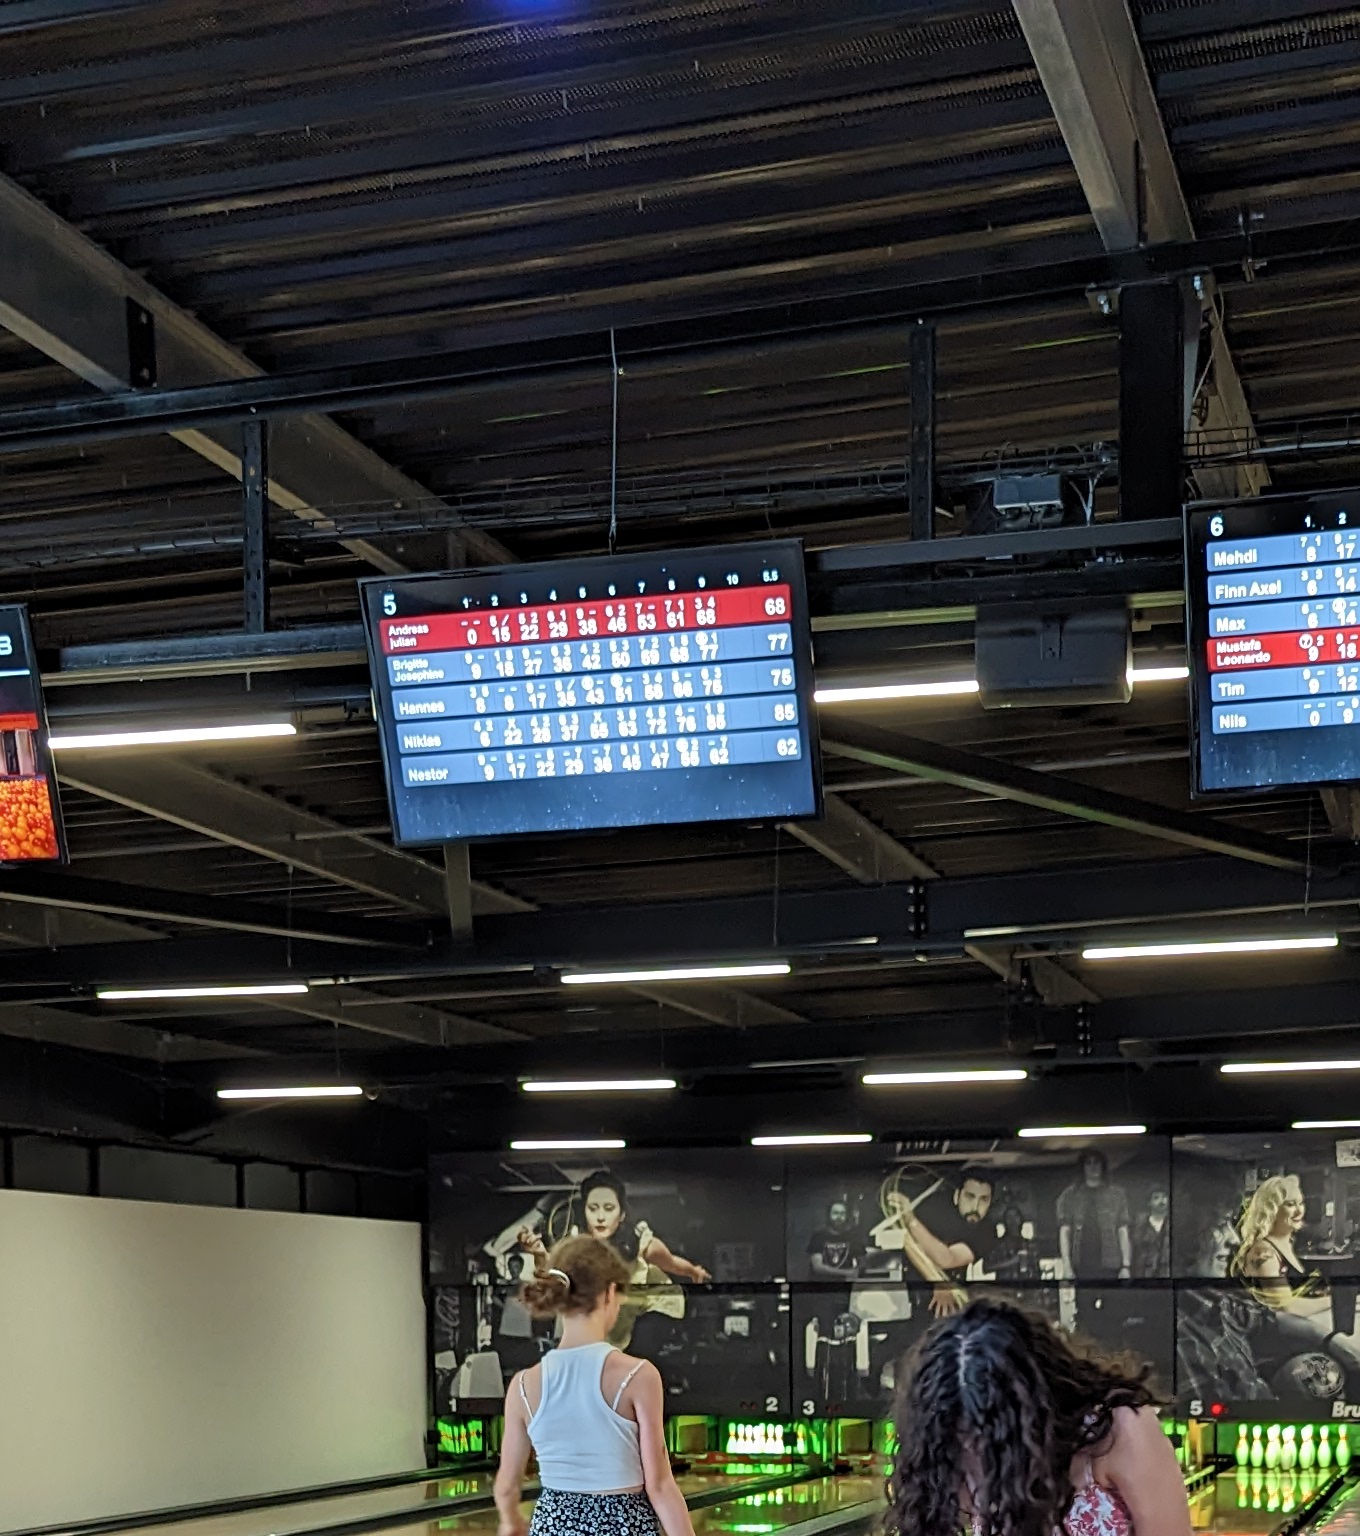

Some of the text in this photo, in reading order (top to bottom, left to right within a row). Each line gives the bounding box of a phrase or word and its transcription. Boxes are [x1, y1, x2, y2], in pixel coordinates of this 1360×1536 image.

[1210, 517, 1223, 536] 6
[1305, 515, 1311, 528] 1
[1339, 512, 1346, 524] 2
[1214, 550, 1257, 566] Mehdi
[1337, 543, 1355, 559] 17
[1216, 580, 1282, 599] Finn Axel
[1337, 577, 1356, 592] 14
[383, 593, 396, 615] 5
[491, 595, 498, 606] 2
[521, 593, 527, 604] 3
[549, 590, 557, 601] 4
[638, 582, 645, 593] 7
[727, 574, 739, 585] 10
[520, 624, 539, 640] 22
[765, 598, 786, 615] 68
[1217, 617, 1245, 632] Max
[388, 624, 429, 636] Andreas
[700, 645, 718, 659] 77
[768, 634, 788, 650] 77
[1217, 640, 1261, 653] Mustafa
[1217, 652, 1271, 666] Leonardo
[771, 668, 792, 686] 75
[1339, 676, 1357, 691] 12
[1218, 682, 1245, 696] Tim
[399, 701, 445, 715] Hannes
[774, 704, 795, 721] 85
[1219, 714, 1247, 729] Nils
[777, 738, 797, 756] 62
[408, 768, 448, 782] Nestor
[449, 1398, 456, 1412] 1
[766, 1397, 777, 1412] 2
[803, 1400, 815, 1415] 3
[1190, 1401, 1202, 1415] 5
